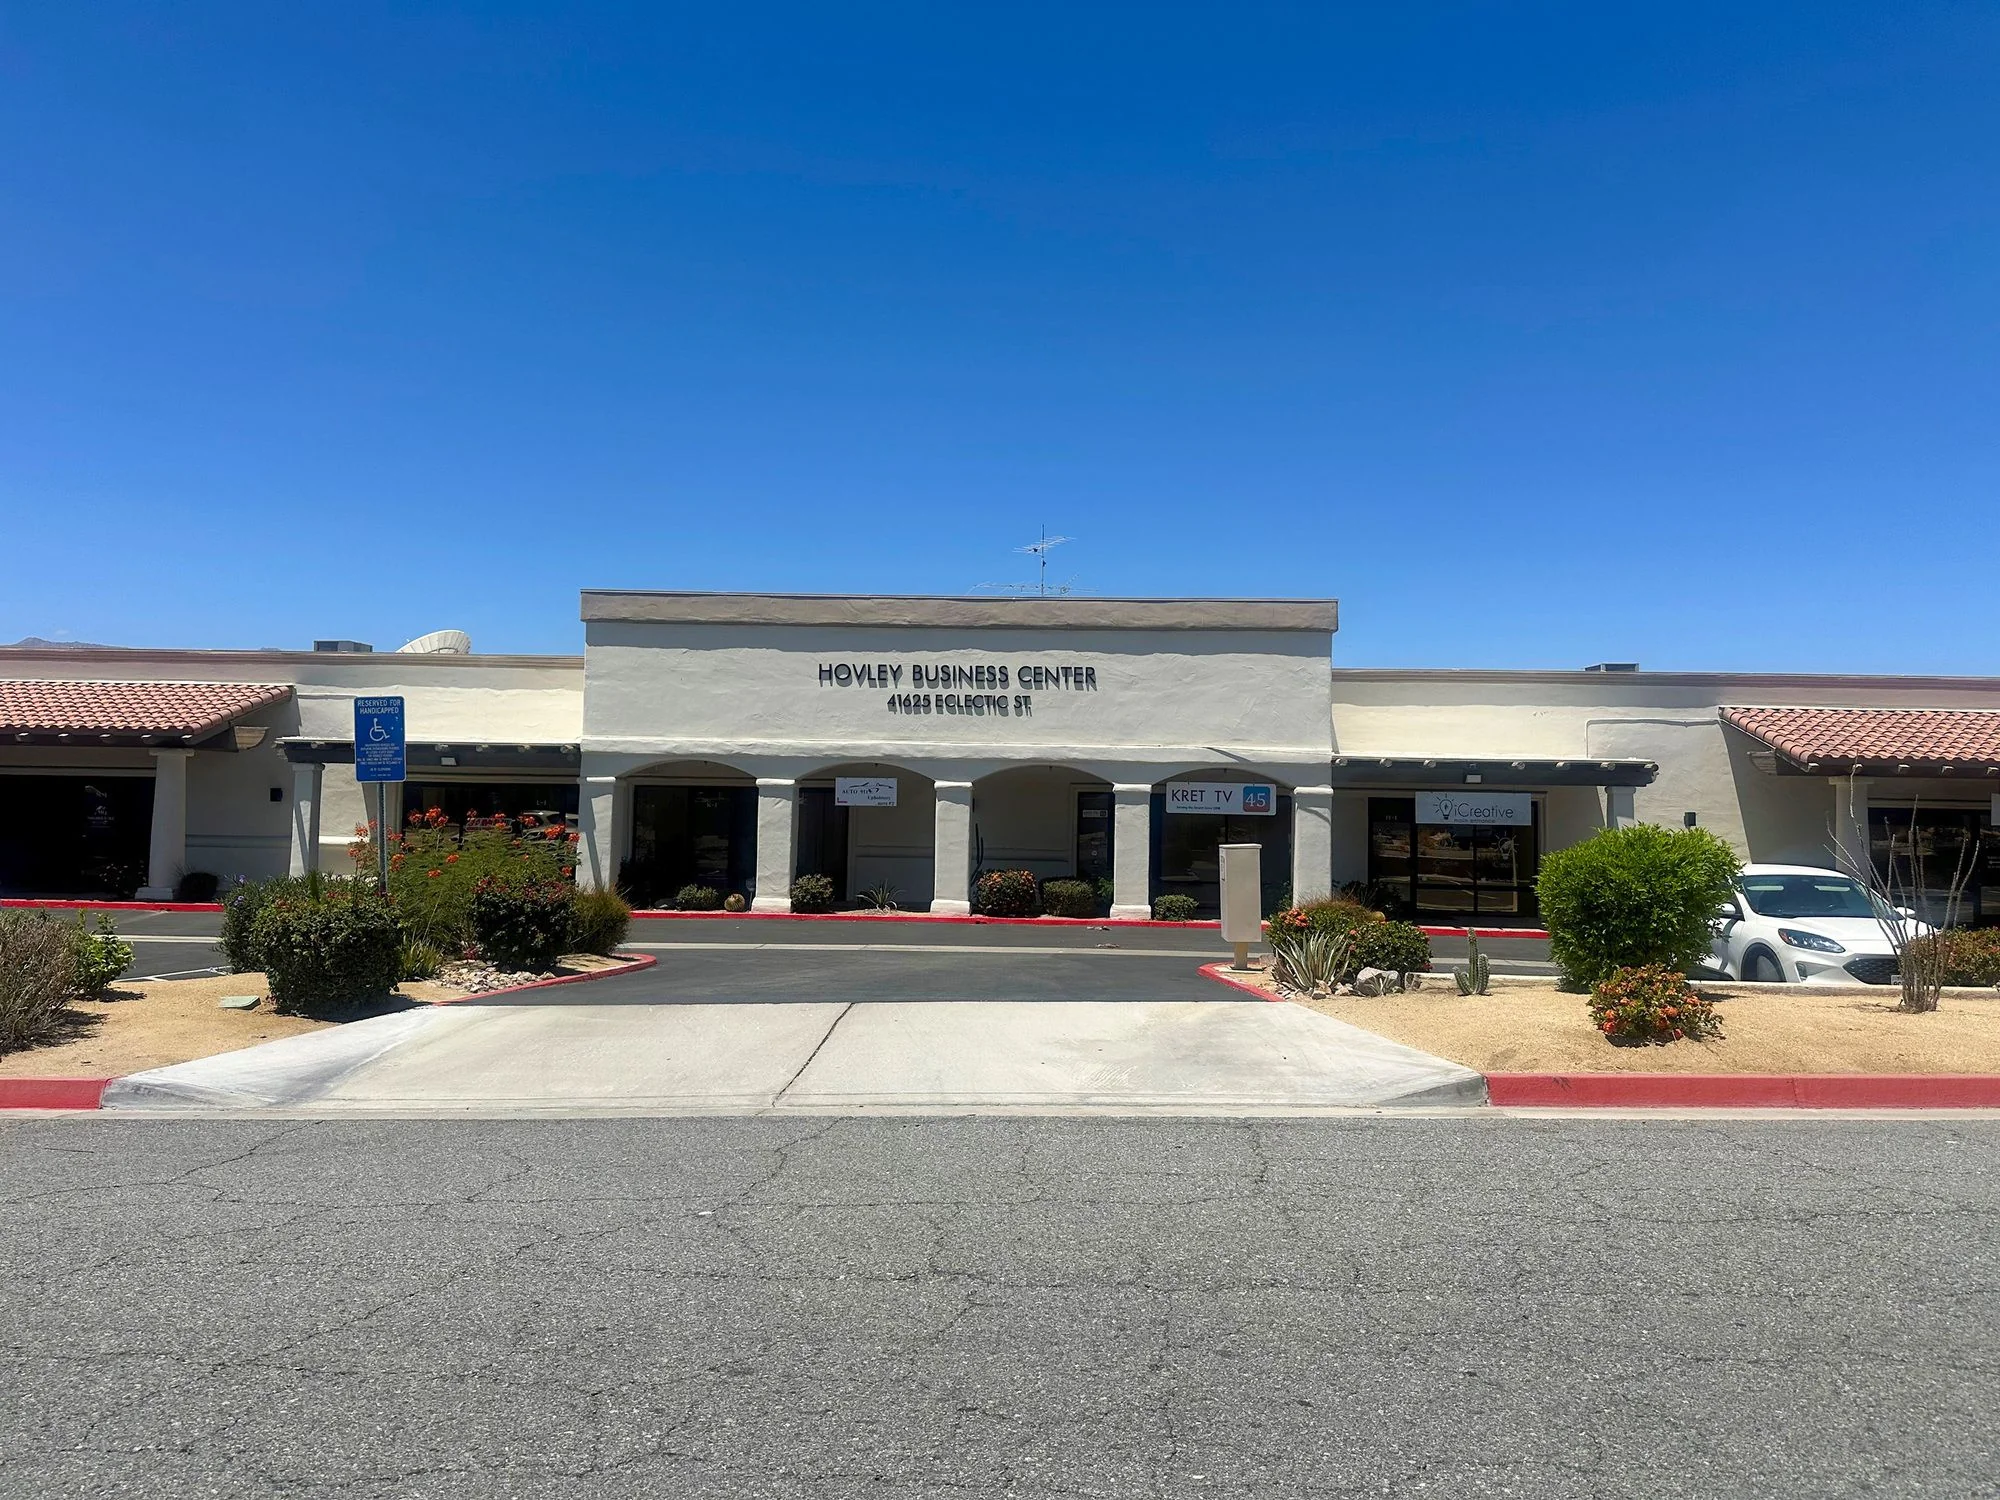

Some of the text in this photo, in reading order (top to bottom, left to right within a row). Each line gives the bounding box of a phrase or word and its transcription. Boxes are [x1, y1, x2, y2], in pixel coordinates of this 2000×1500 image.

[819, 664, 1097, 684] HOVLEY BUSINESS CENTER
[887, 694, 1032, 709] 41625 ECLECTIC ST.
[1171, 789, 1233, 803] KRET TV
[1246, 792, 1266, 808] 45
[1454, 802, 1514, 818] iCreative
